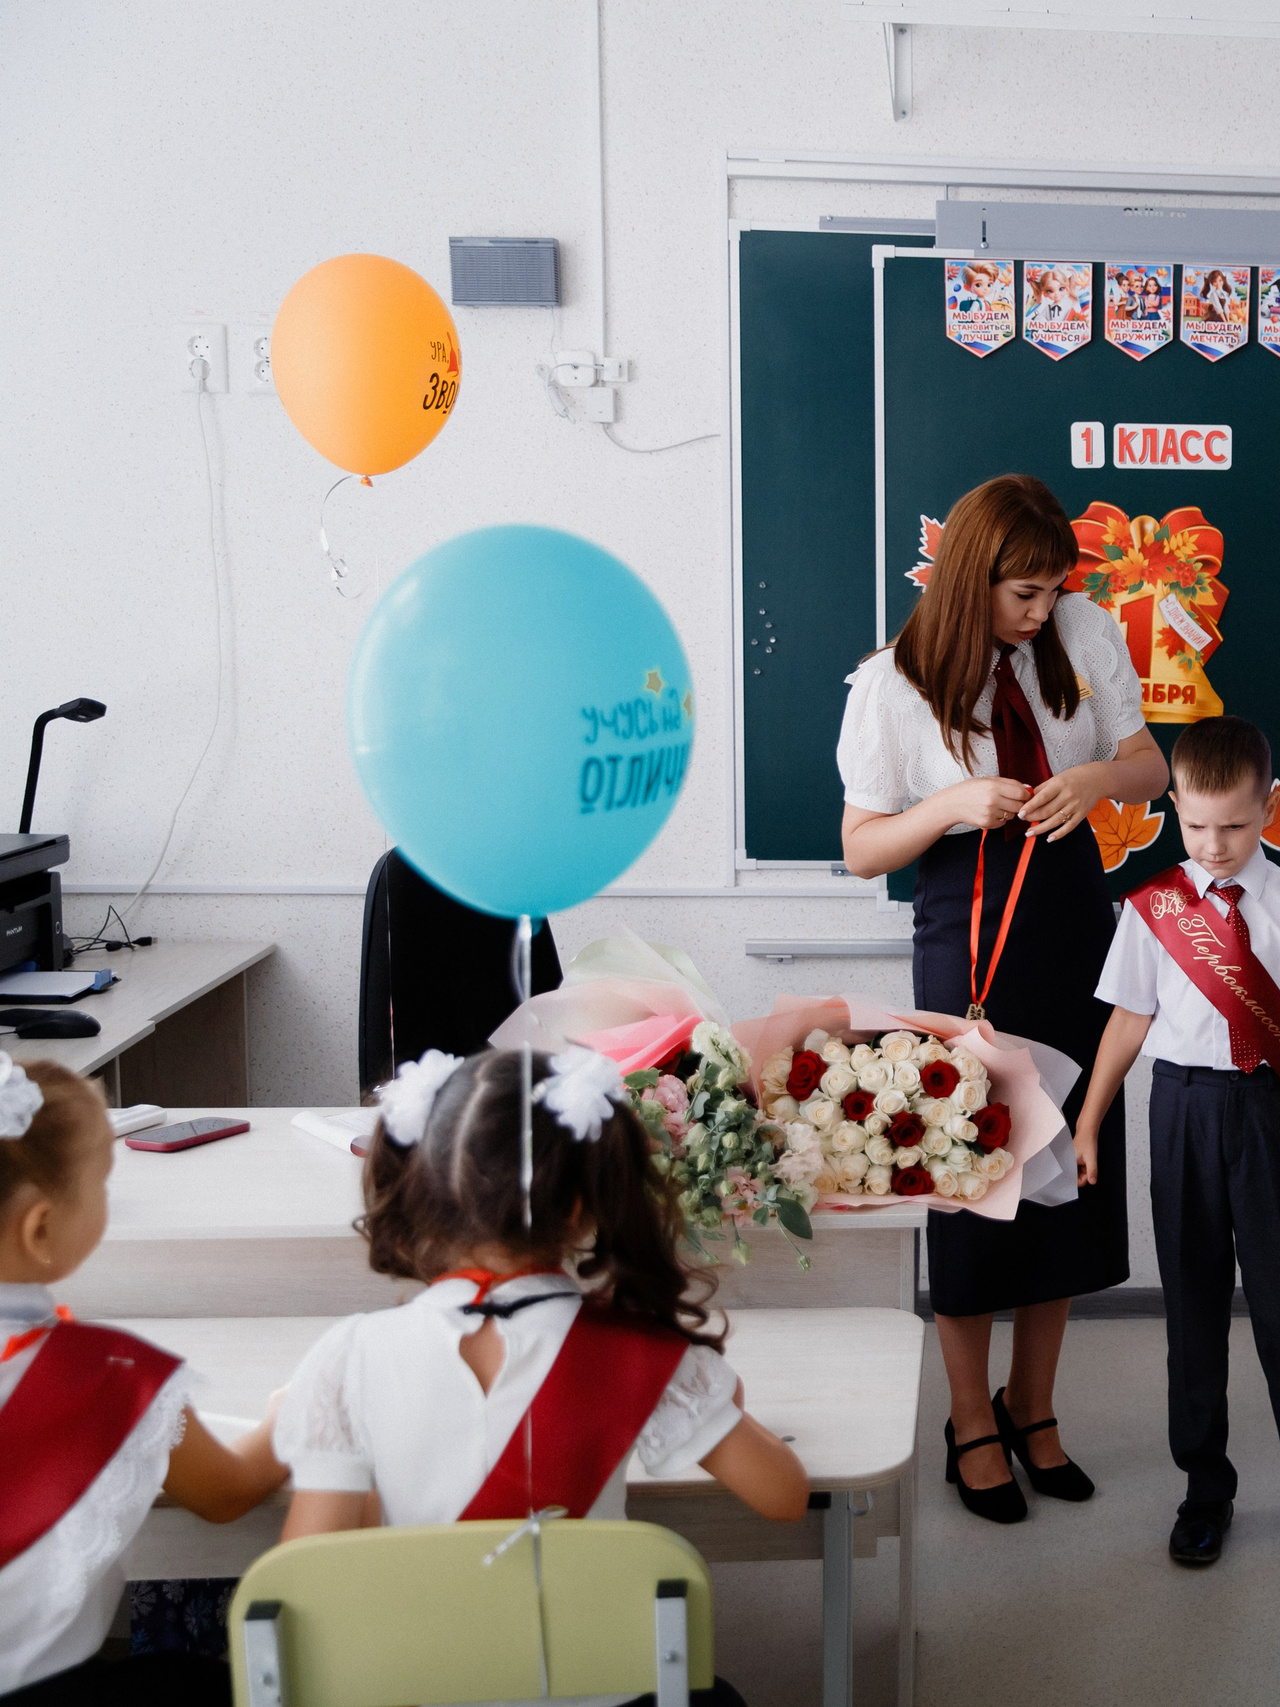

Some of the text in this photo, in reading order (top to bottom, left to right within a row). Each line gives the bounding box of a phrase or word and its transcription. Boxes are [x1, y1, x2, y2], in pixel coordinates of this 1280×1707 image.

[952, 312, 1010, 321] МЫ БУДЕМ
[952, 323, 1011, 331] СТАНОВИТЬСЯ
[1029, 321, 1086, 331] МЫ БУДЕМ
[1110, 321, 1168, 330] МЫ БУДЕМ
[1186, 322, 1242, 333] МЫ БУДЕМ
[962, 333, 1000, 342] ЛУЧШЕ
[1034, 332, 1080, 342] УЧИТЬСЯ
[1114, 332, 1165, 342] ДРУЖИТЬ
[1190, 335, 1237, 344] МЕЧТАТЬ
[422, 372, 460, 415] ЗВО
[1080, 427, 1229, 465] 1 КЛАСС
